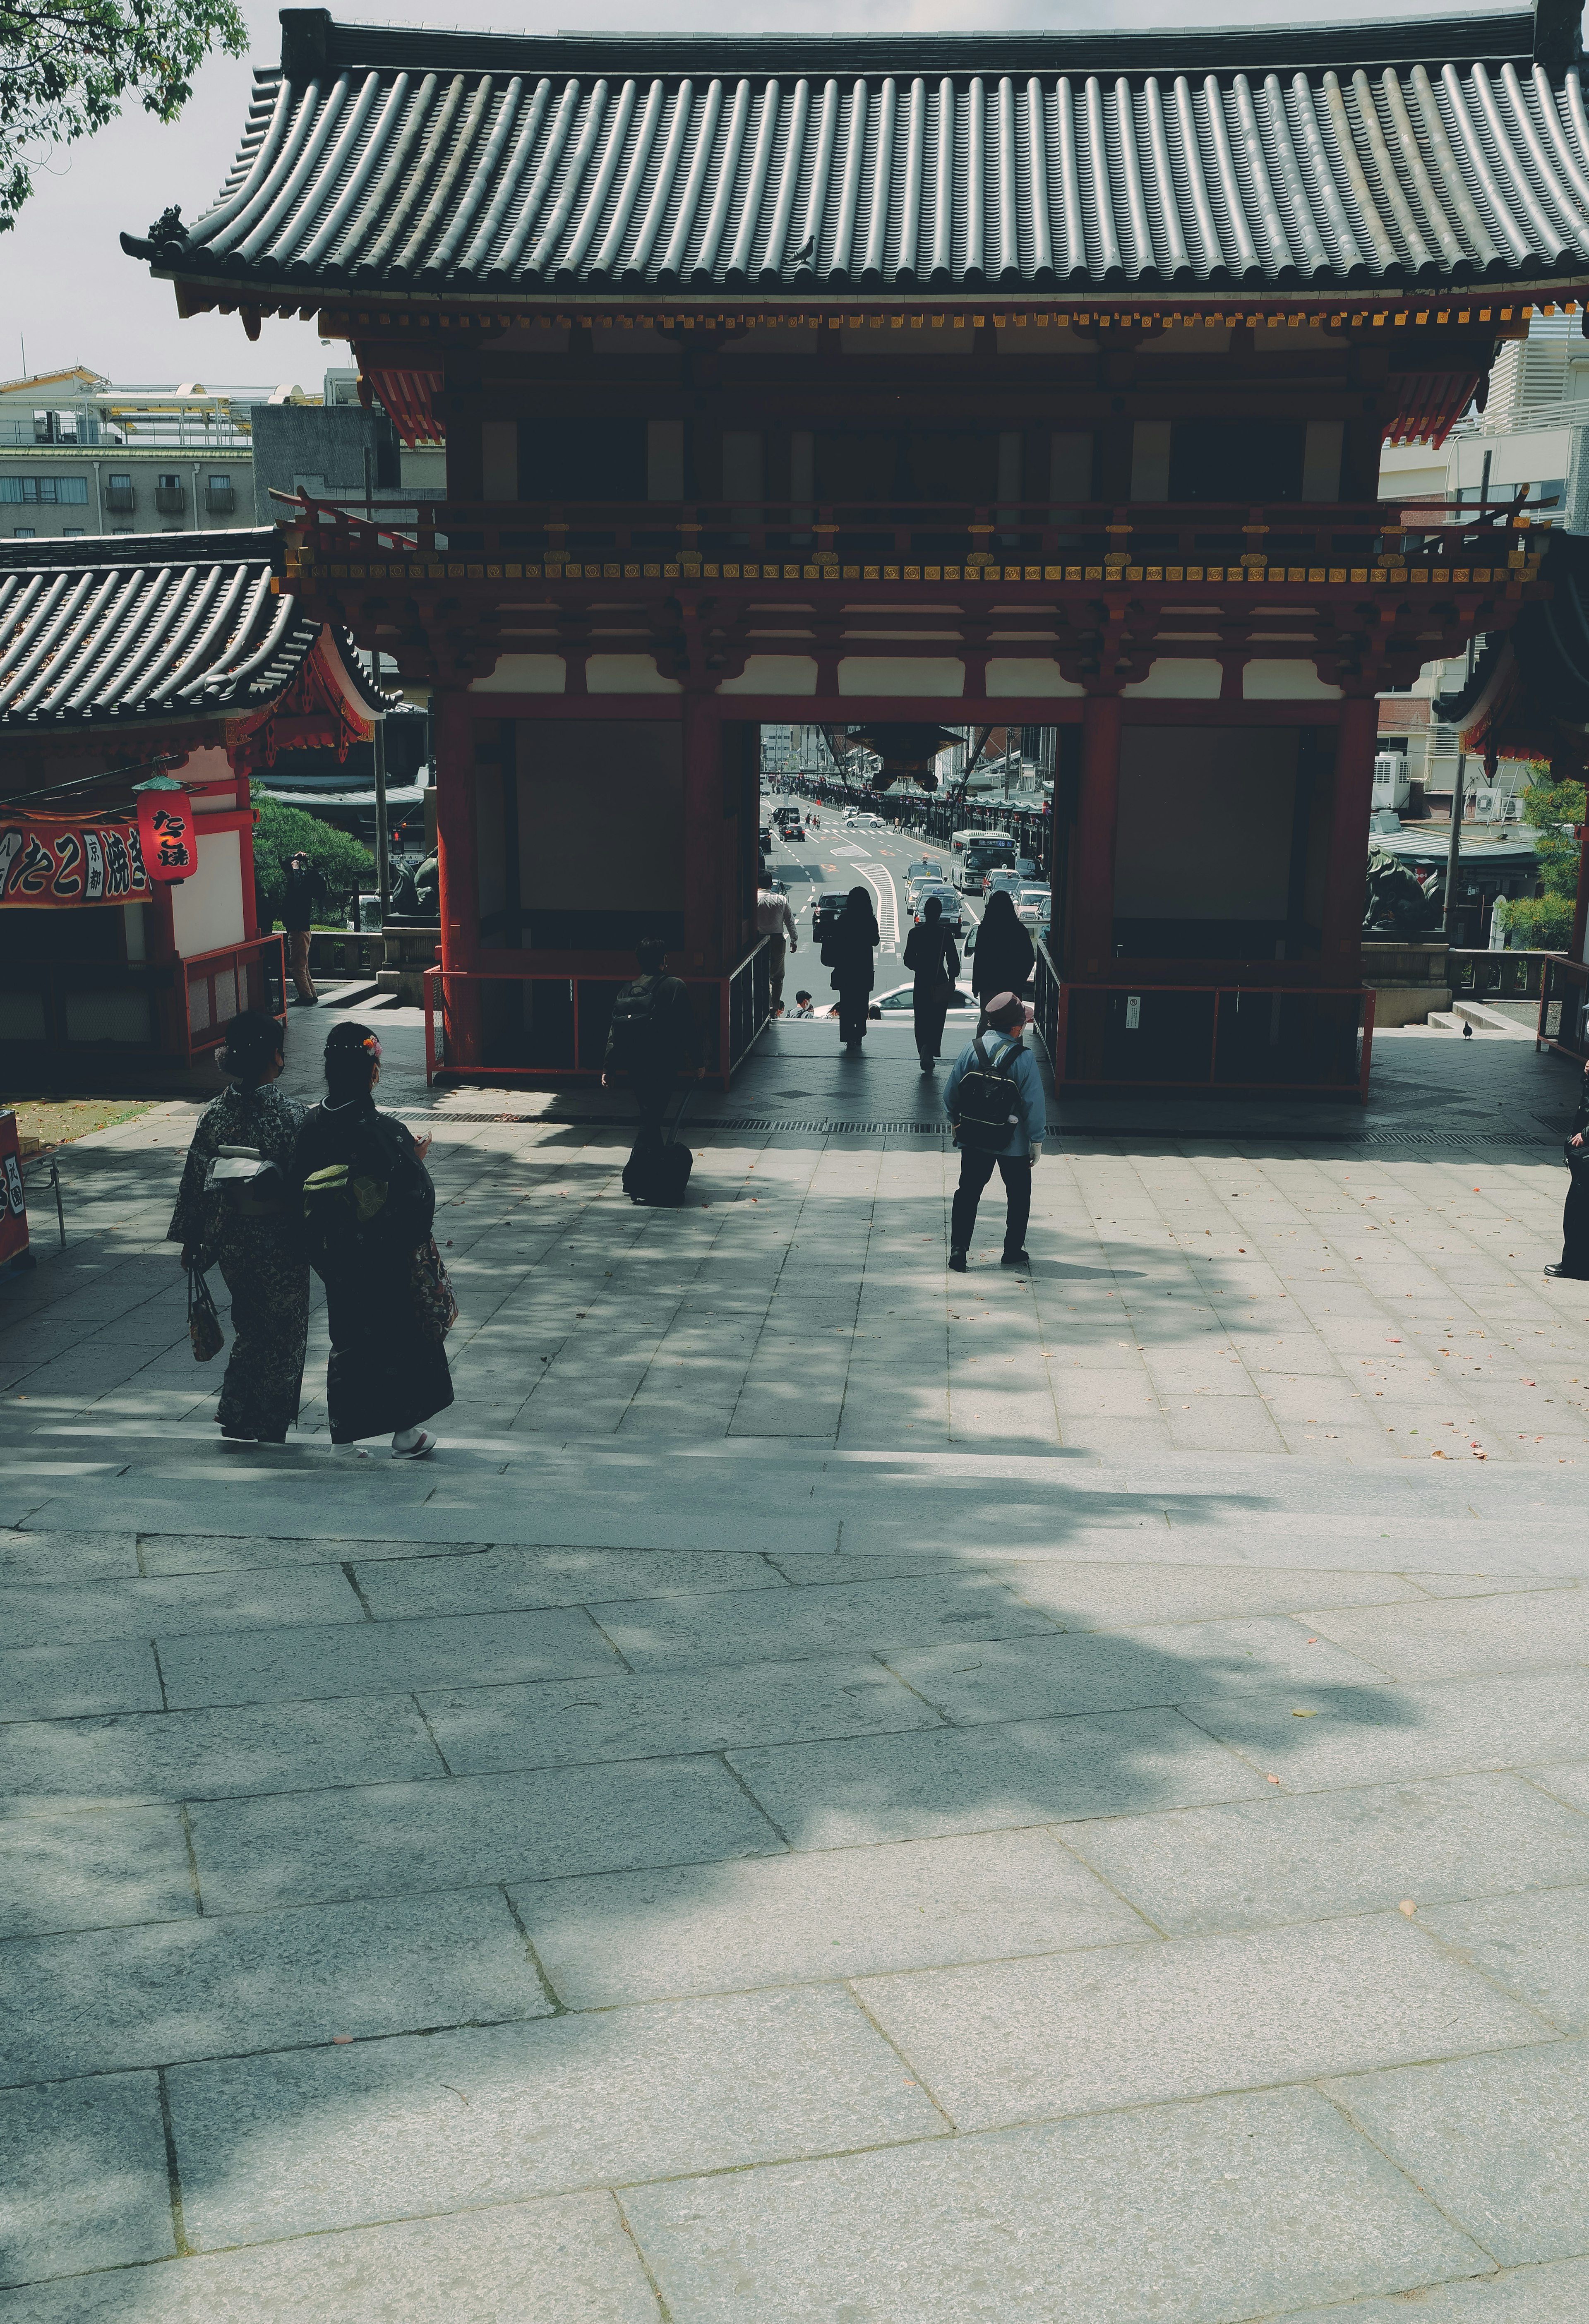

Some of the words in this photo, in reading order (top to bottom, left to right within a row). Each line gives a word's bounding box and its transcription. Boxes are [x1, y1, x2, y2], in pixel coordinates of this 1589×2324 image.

[88, 838, 102, 890] 京都
[151, 810, 190, 867] たこ焼
